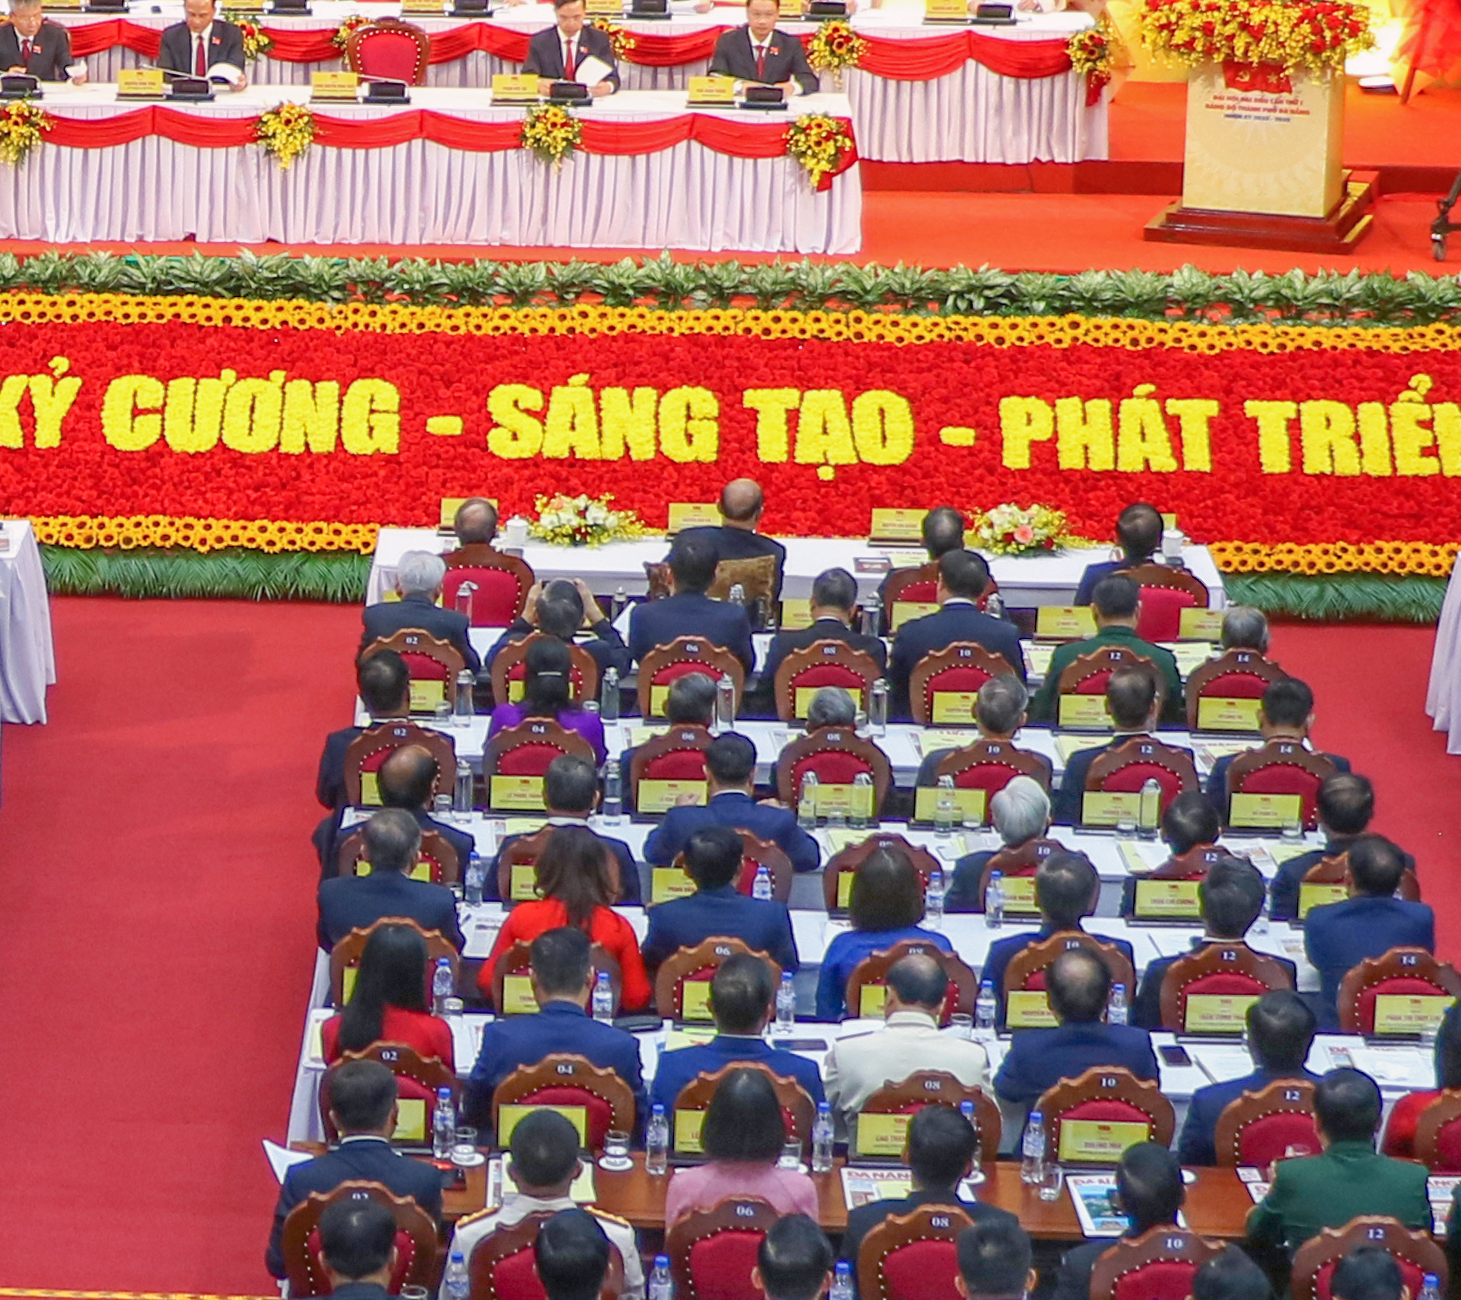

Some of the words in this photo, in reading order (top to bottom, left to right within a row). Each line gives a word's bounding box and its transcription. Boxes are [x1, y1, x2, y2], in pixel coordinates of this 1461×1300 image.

[100, 368, 401, 455] CƯƠNG
[487, 373, 719, 463] SÁNG
[743, 387, 914, 480] TẠO
[999, 383, 1220, 472] PHÁT
